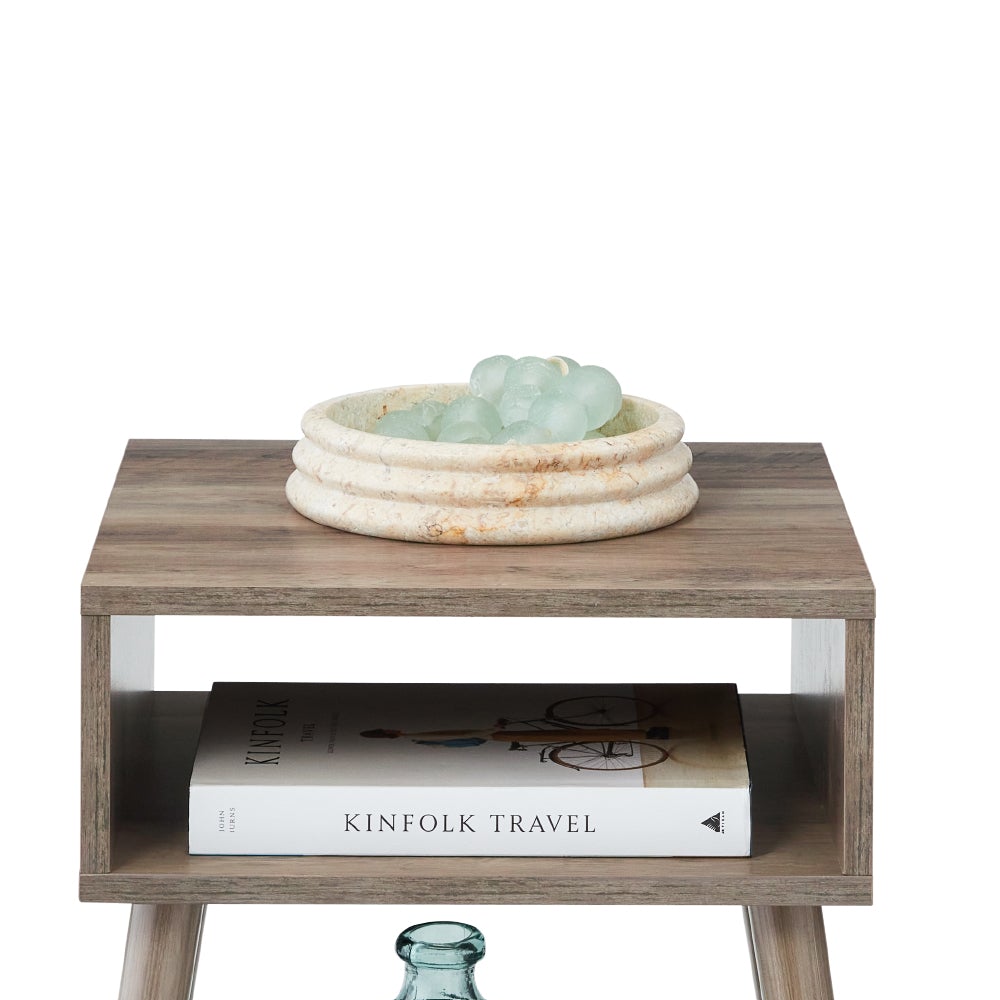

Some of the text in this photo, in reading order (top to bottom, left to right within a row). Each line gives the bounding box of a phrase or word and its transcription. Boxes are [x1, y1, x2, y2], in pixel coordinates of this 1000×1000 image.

[245, 699, 291, 765] KINFOLK
[344, 813, 597, 833] KINFOLK TRAVEL
